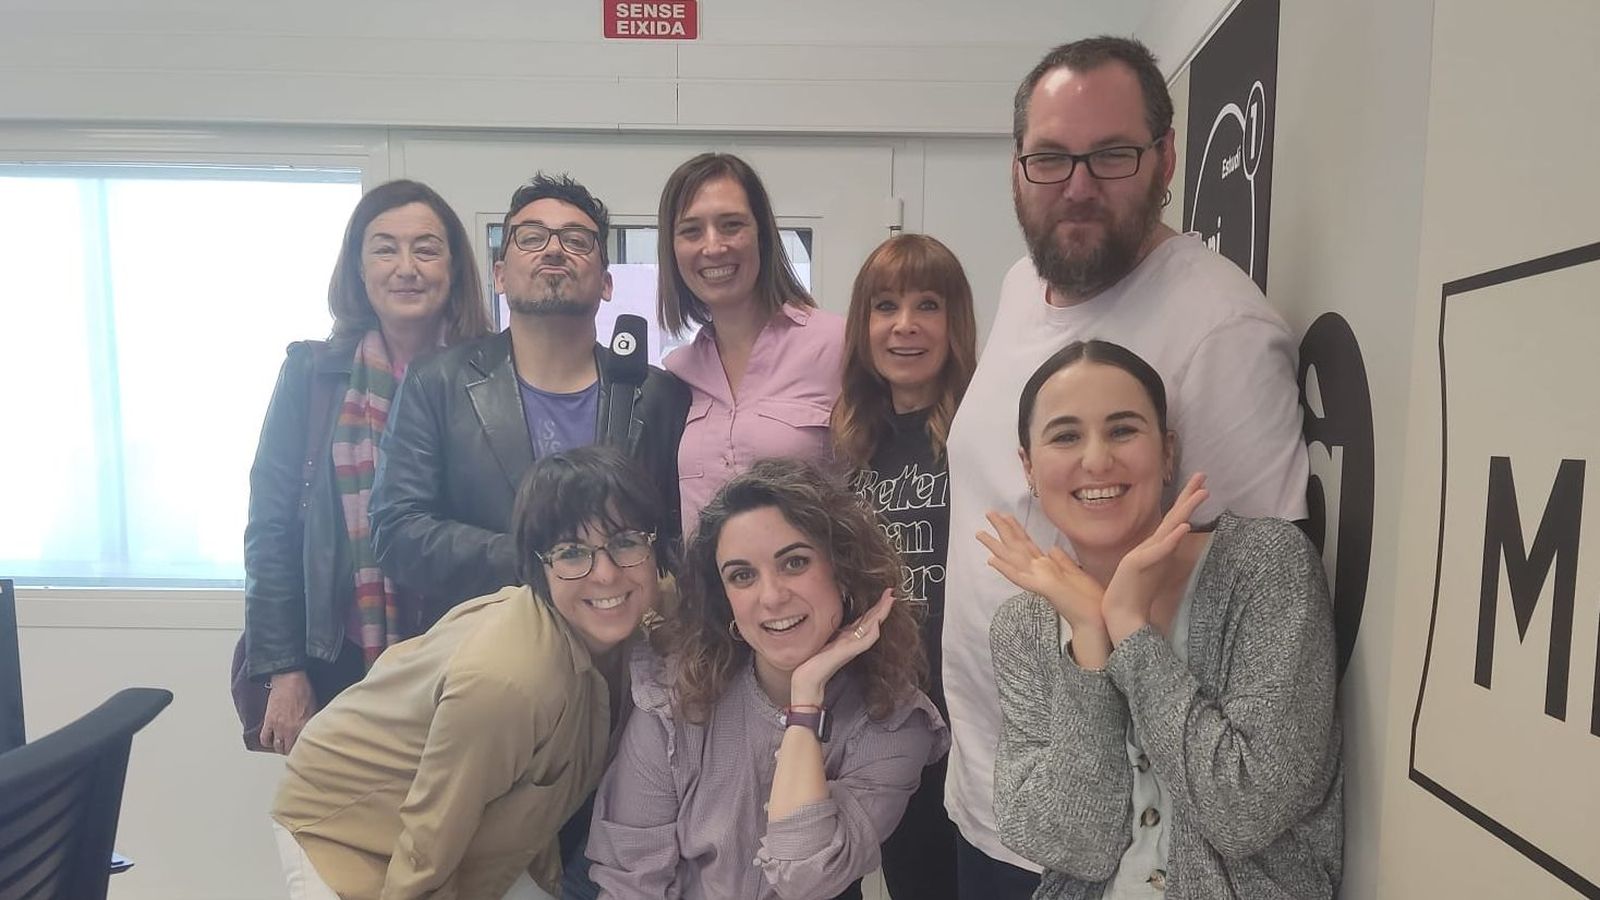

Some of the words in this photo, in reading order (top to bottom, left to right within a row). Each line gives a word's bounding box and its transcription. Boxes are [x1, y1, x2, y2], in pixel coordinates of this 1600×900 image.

[616, 3, 686, 18] SENSE
[616, 20, 686, 35] EIXIDA
[1222, 145, 1241, 179] Estudi
[1250, 101, 1258, 160] 1
[1474, 456, 1600, 737] M
